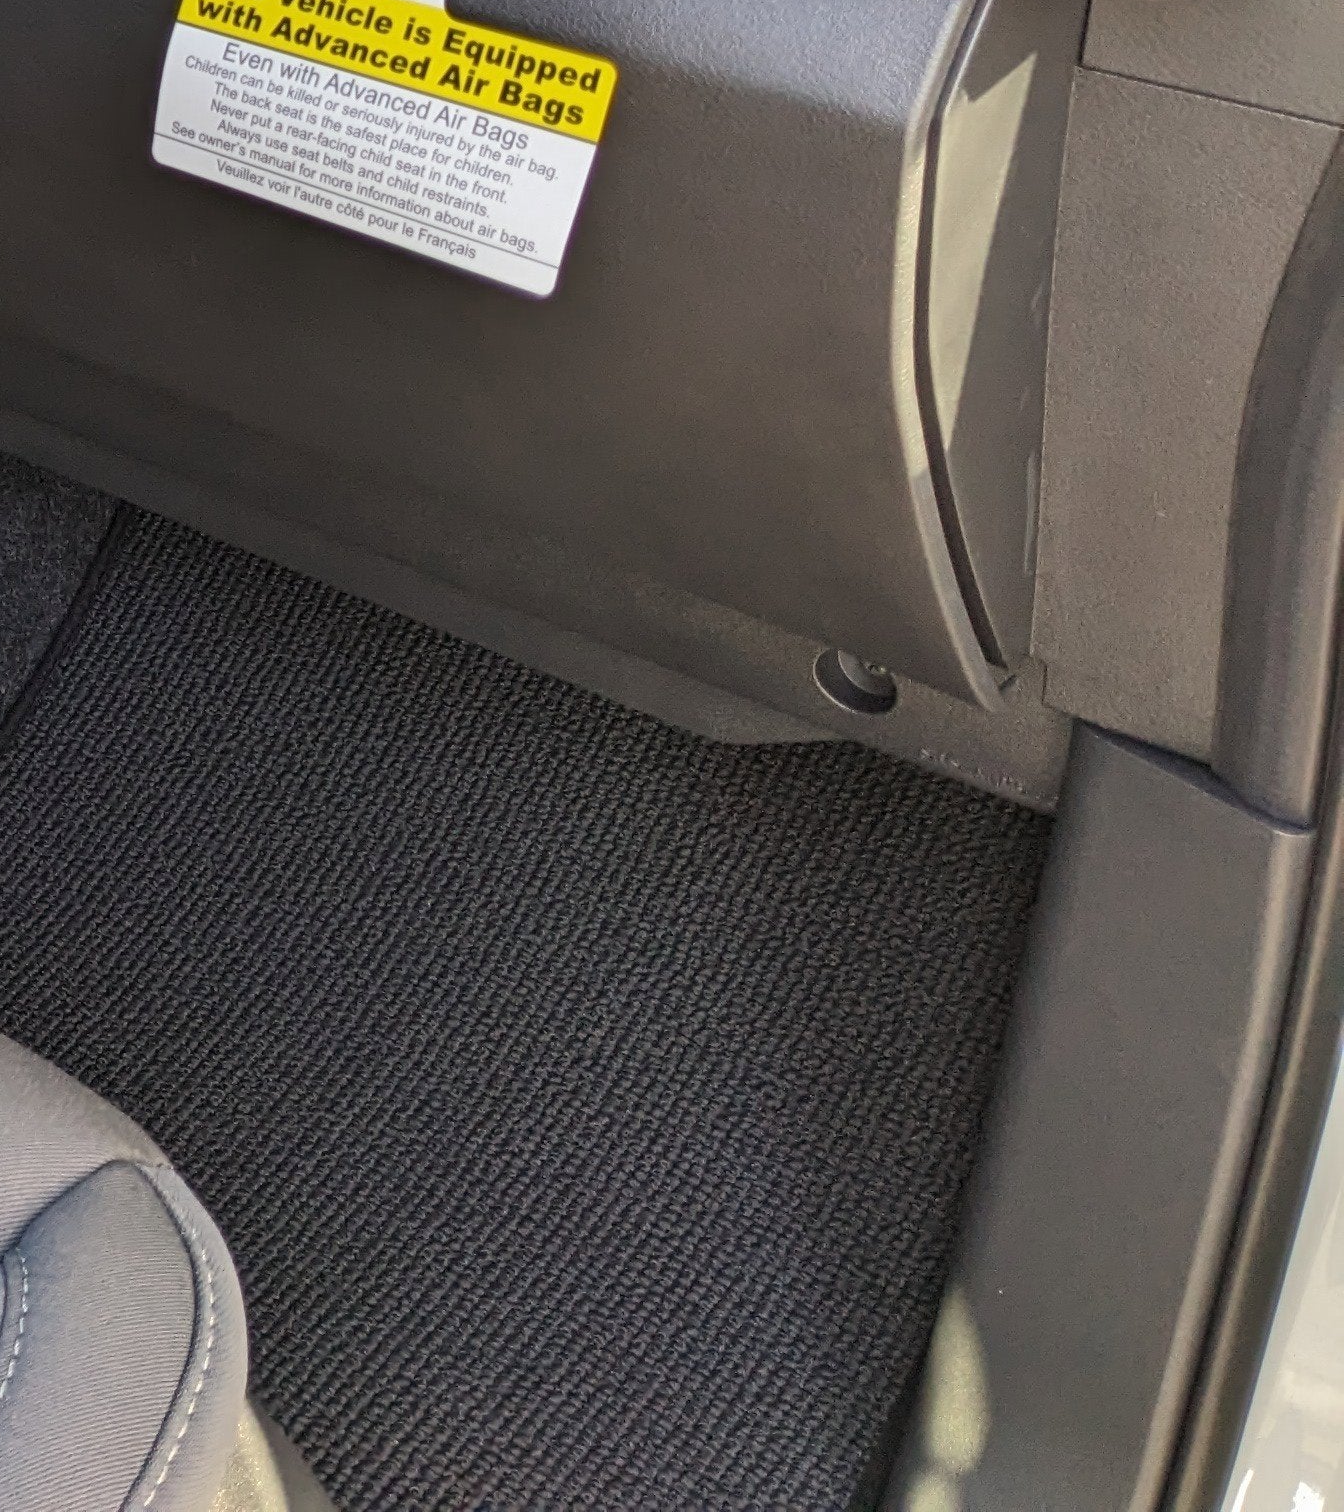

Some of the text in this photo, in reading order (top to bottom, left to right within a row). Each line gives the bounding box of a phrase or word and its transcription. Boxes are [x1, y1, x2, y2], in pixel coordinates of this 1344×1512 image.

[223, 42, 529, 150] Even with Advanced Air Bags
[270, 16, 432, 81] Advanced
[438, 64, 490, 96] Air
[498, 79, 584, 126] Bags
[403, 17, 432, 45] is
[442, 27, 601, 94] Equipped
[185, 55, 559, 182] Children can be killed or seriously injured by the air bag.
[211, 99, 507, 204] Never put a rear-facing child seat in the front.
[214, 81, 513, 186] The back seat is the safest place for children.
[217, 119, 490, 218] Always use seat belts and child restraints.
[172, 121, 538, 254] See owner's manual for more information about air bags.
[216, 159, 477, 260] Veuillez voir l'autre côté pour le Français
